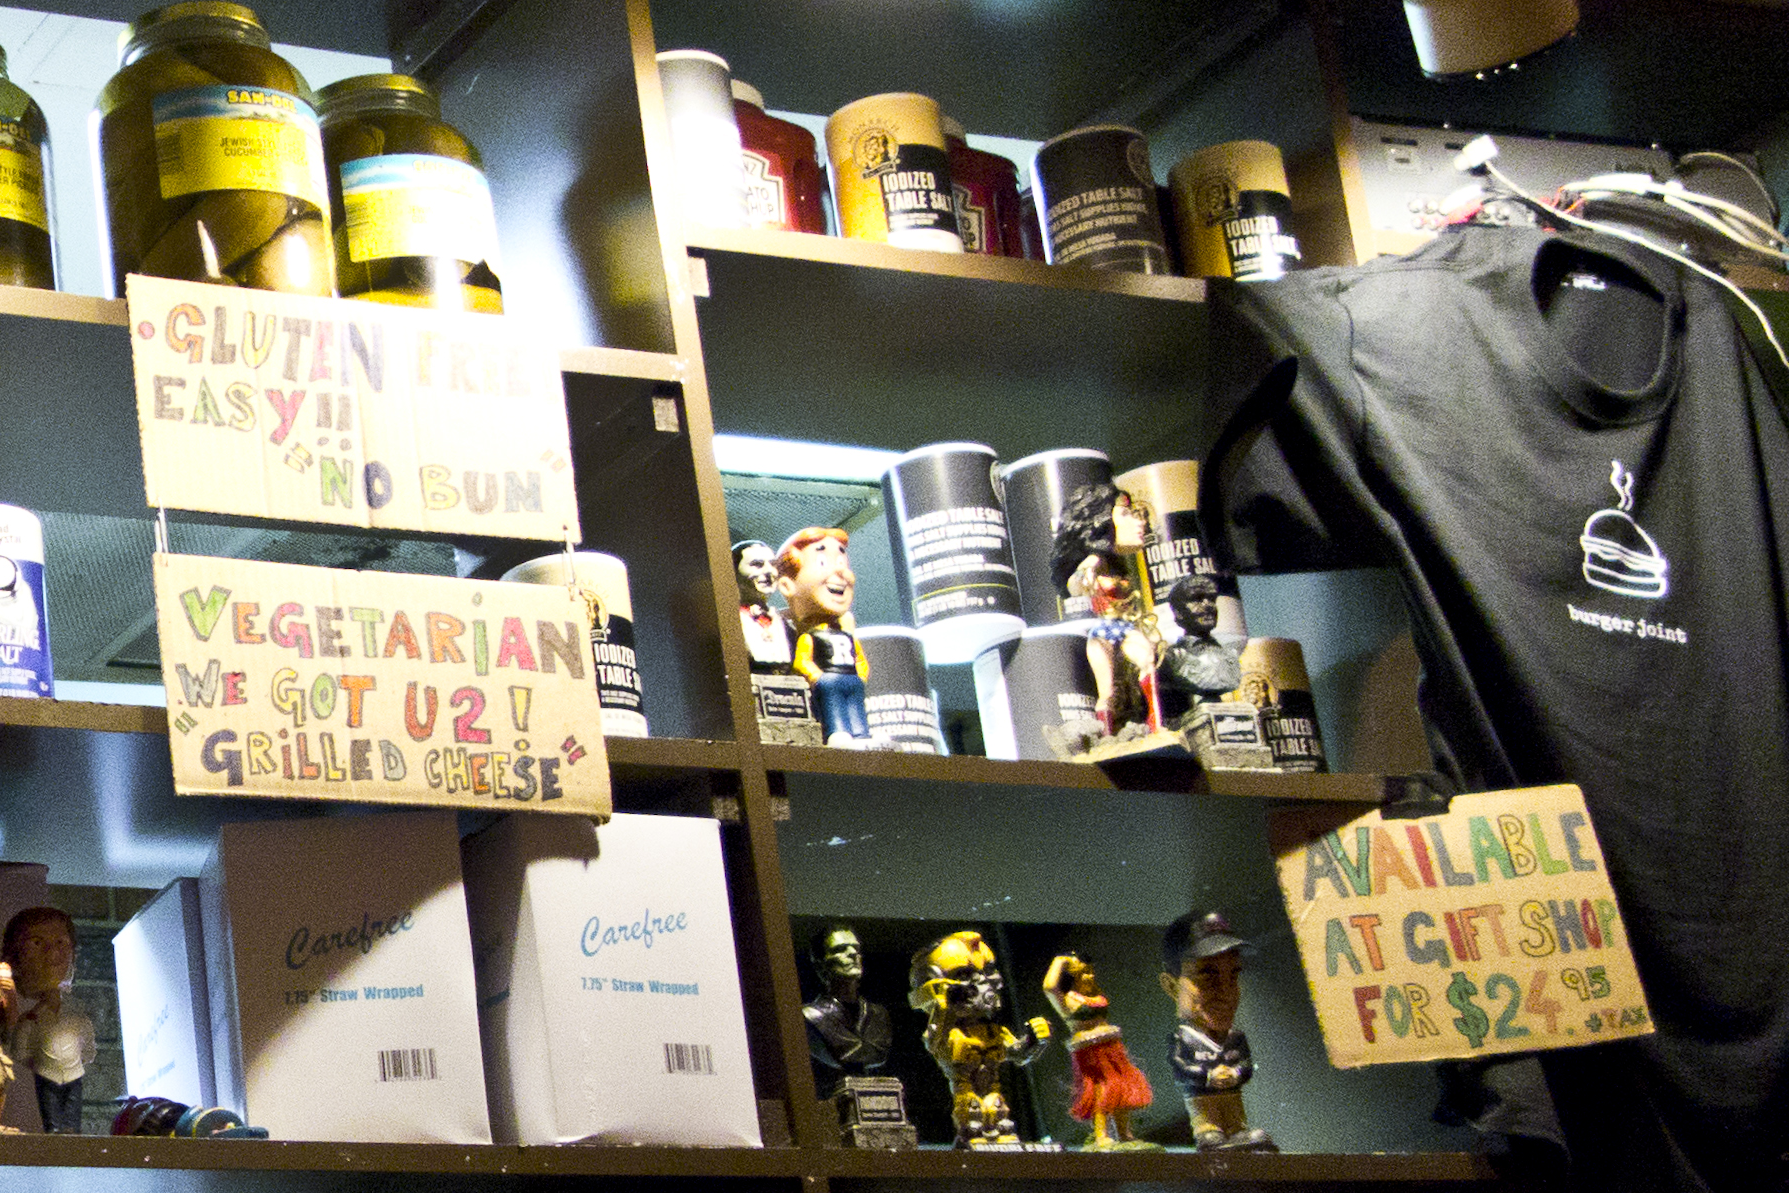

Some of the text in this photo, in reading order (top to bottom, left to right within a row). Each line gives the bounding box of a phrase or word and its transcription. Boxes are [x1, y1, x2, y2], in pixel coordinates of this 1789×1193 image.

[882, 170, 937, 193] IODIZED
[886, 191, 928, 213] TABLE
[1082, 188, 1116, 209] TABLE
[1226, 216, 1279, 239] IODIZED
[164, 302, 385, 393] GLUTEN
[949, 507, 985, 525] TABLE
[1144, 538, 1200, 564] IODIZED
[1149, 558, 1191, 584] TABLE
[1566, 604, 1688, 646] burger joint
[828, 633, 854, 667] R
[597, 664, 633, 689] TABLE
[176, 658, 249, 709] WE
[269, 666, 377, 730] GOT
[1302, 811, 1598, 901] AVAILABLE
[285, 910, 414, 971] Carefree
[579, 907, 689, 958] Carefree
[1325, 898, 1617, 978] AT GIFT SHOP
[320, 986, 359, 1003] Straw
[363, 983, 425, 1002] Wrapped
[612, 978, 646, 994] Straw
[648, 980, 701, 997] Wrapped
[1352, 981, 1441, 1045] FOR
